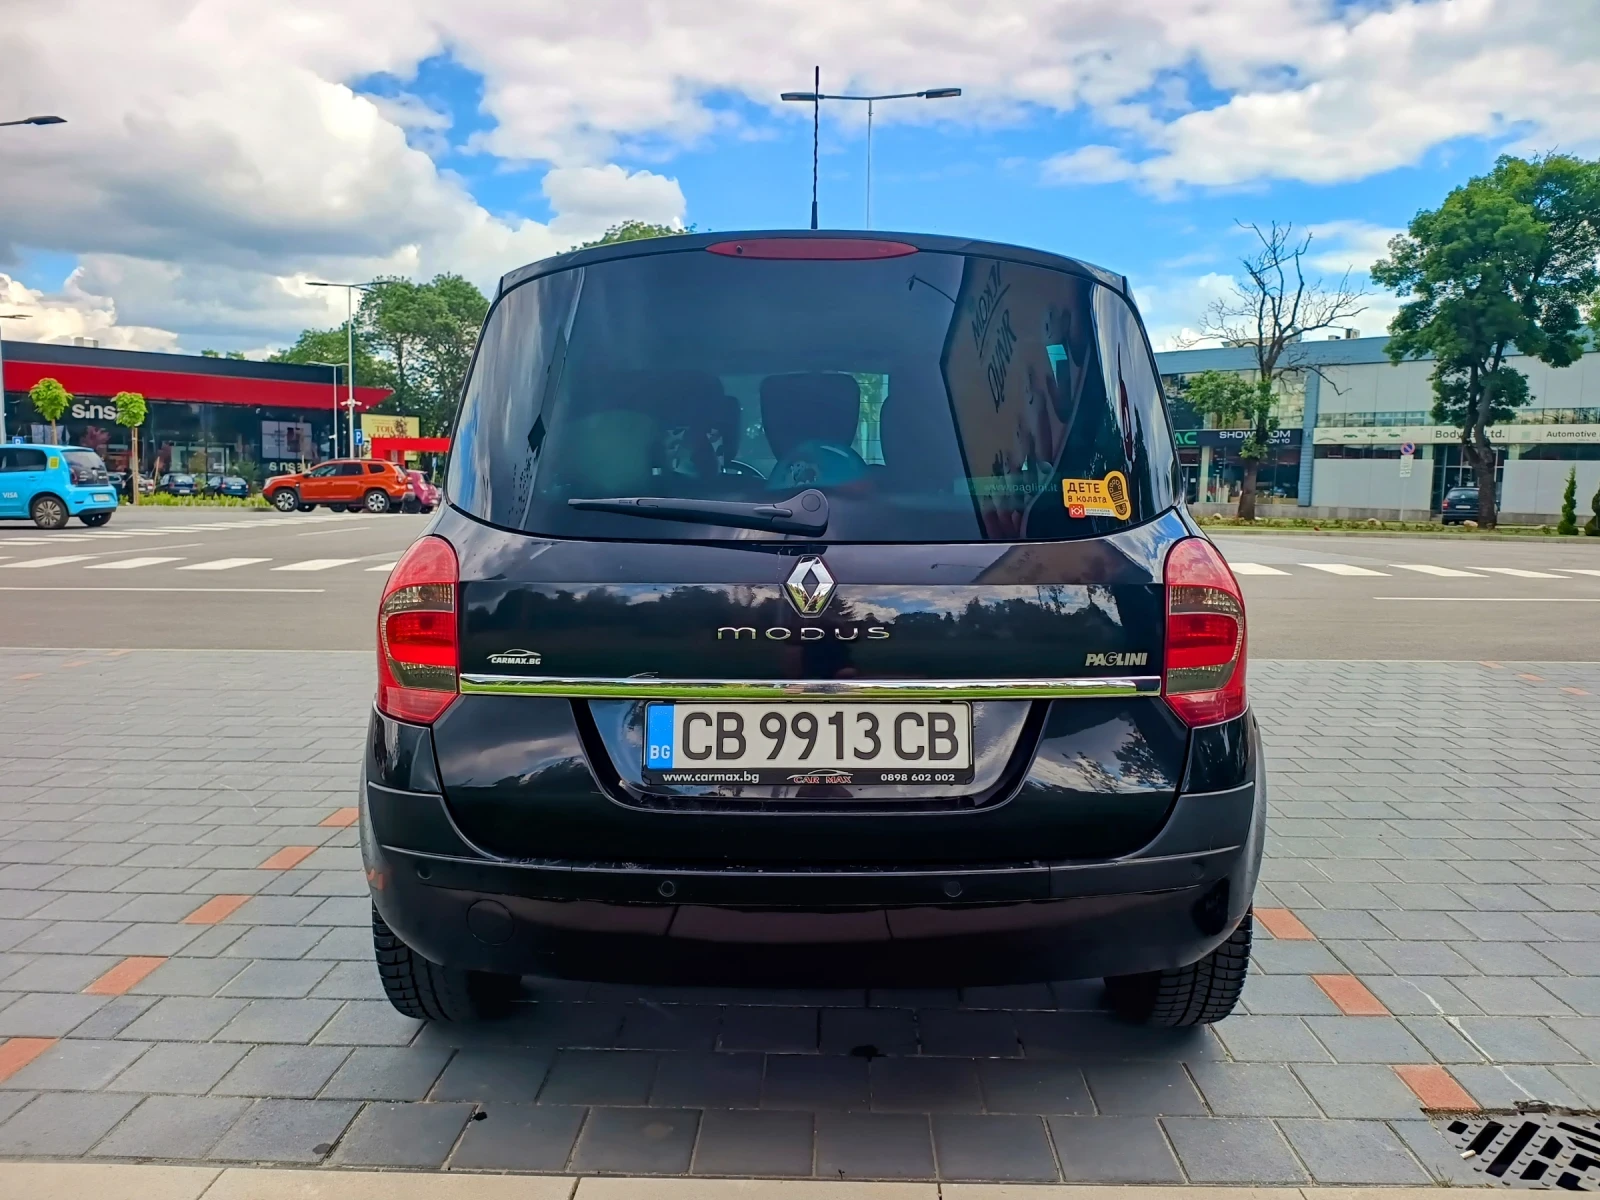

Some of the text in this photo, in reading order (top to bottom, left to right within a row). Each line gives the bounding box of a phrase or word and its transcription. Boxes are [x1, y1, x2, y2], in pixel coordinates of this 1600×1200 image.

[72, 400, 117, 420] sins
[356, 431, 361, 443] P
[1546, 430, 1597, 438] Automotive
[1067, 482, 1100, 494] ДЕТЕ
[1076, 495, 1107, 503] колата
[717, 627, 890, 640] MODUS
[491, 657, 541, 665] CARMAX.BG
[1085, 652, 1148, 666] PAGLINI
[682, 712, 959, 760] CB 9913 CB
[650, 745, 670, 759] BG
[662, 771, 760, 784] www.carmax.bg
[793, 776, 852, 784] CAR MAX
[880, 773, 955, 782] 0898 602 002
